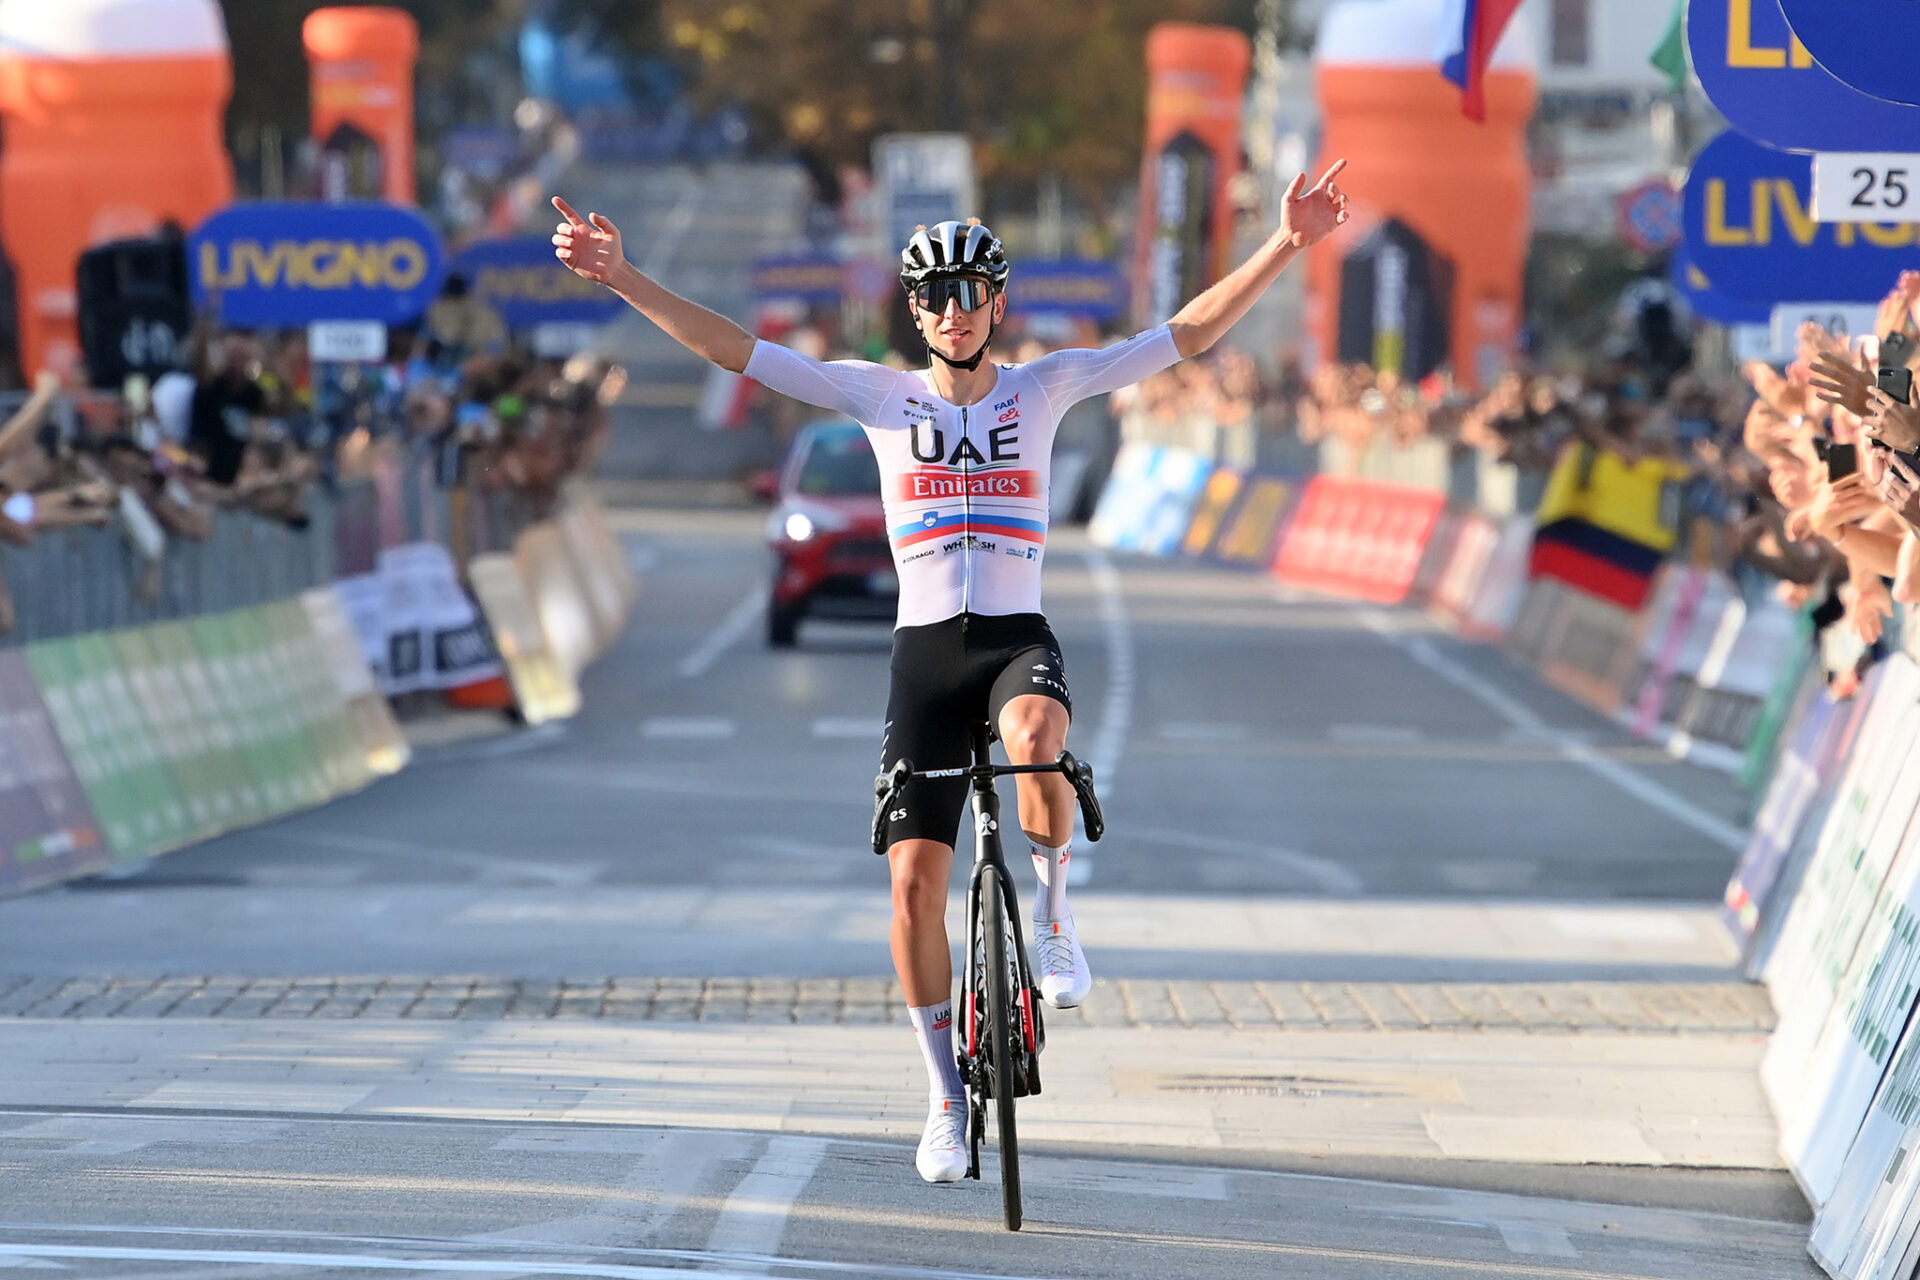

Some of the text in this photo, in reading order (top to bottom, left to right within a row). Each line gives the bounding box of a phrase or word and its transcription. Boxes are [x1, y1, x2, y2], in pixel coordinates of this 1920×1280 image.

[1851, 168, 1907, 208] 25
[202, 239, 428, 289] LIVIGNO
[910, 422, 1020, 466] UAE
[913, 475, 1020, 497] Emirates
